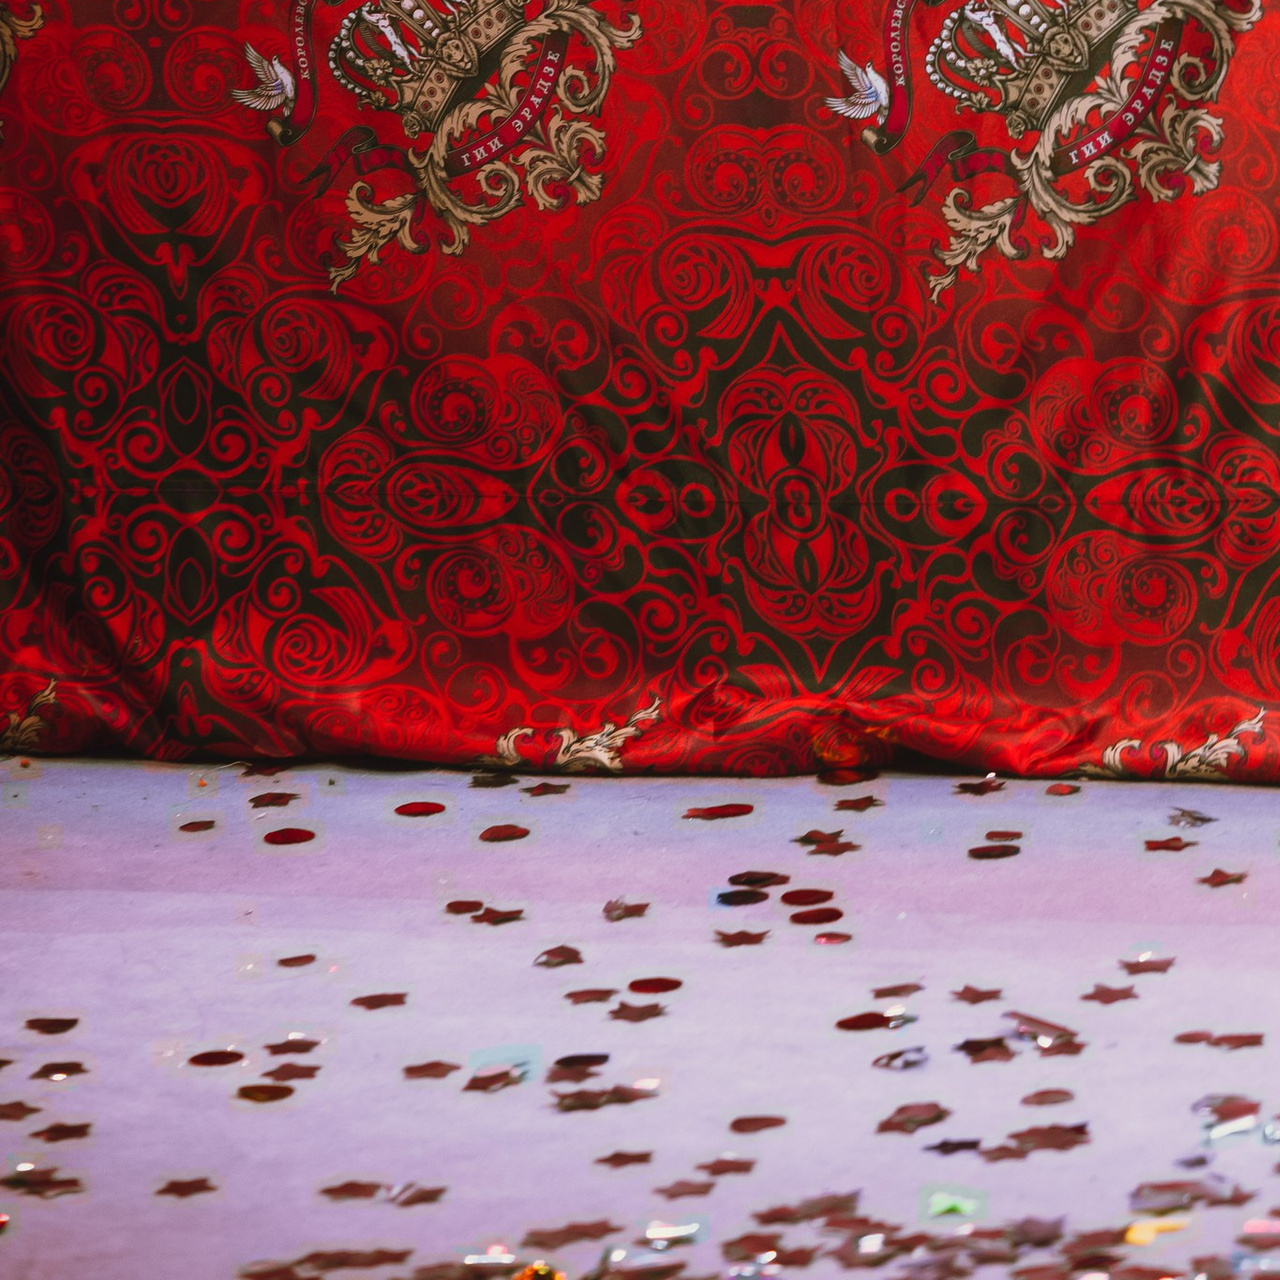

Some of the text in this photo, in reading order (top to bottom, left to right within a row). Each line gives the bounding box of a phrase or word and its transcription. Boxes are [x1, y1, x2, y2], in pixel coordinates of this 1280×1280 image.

[460, 49, 561, 167] ГИИ ЭРАДЗЕ
[1068, 38, 1174, 165] ГИИ ЭРАДЗЕ
